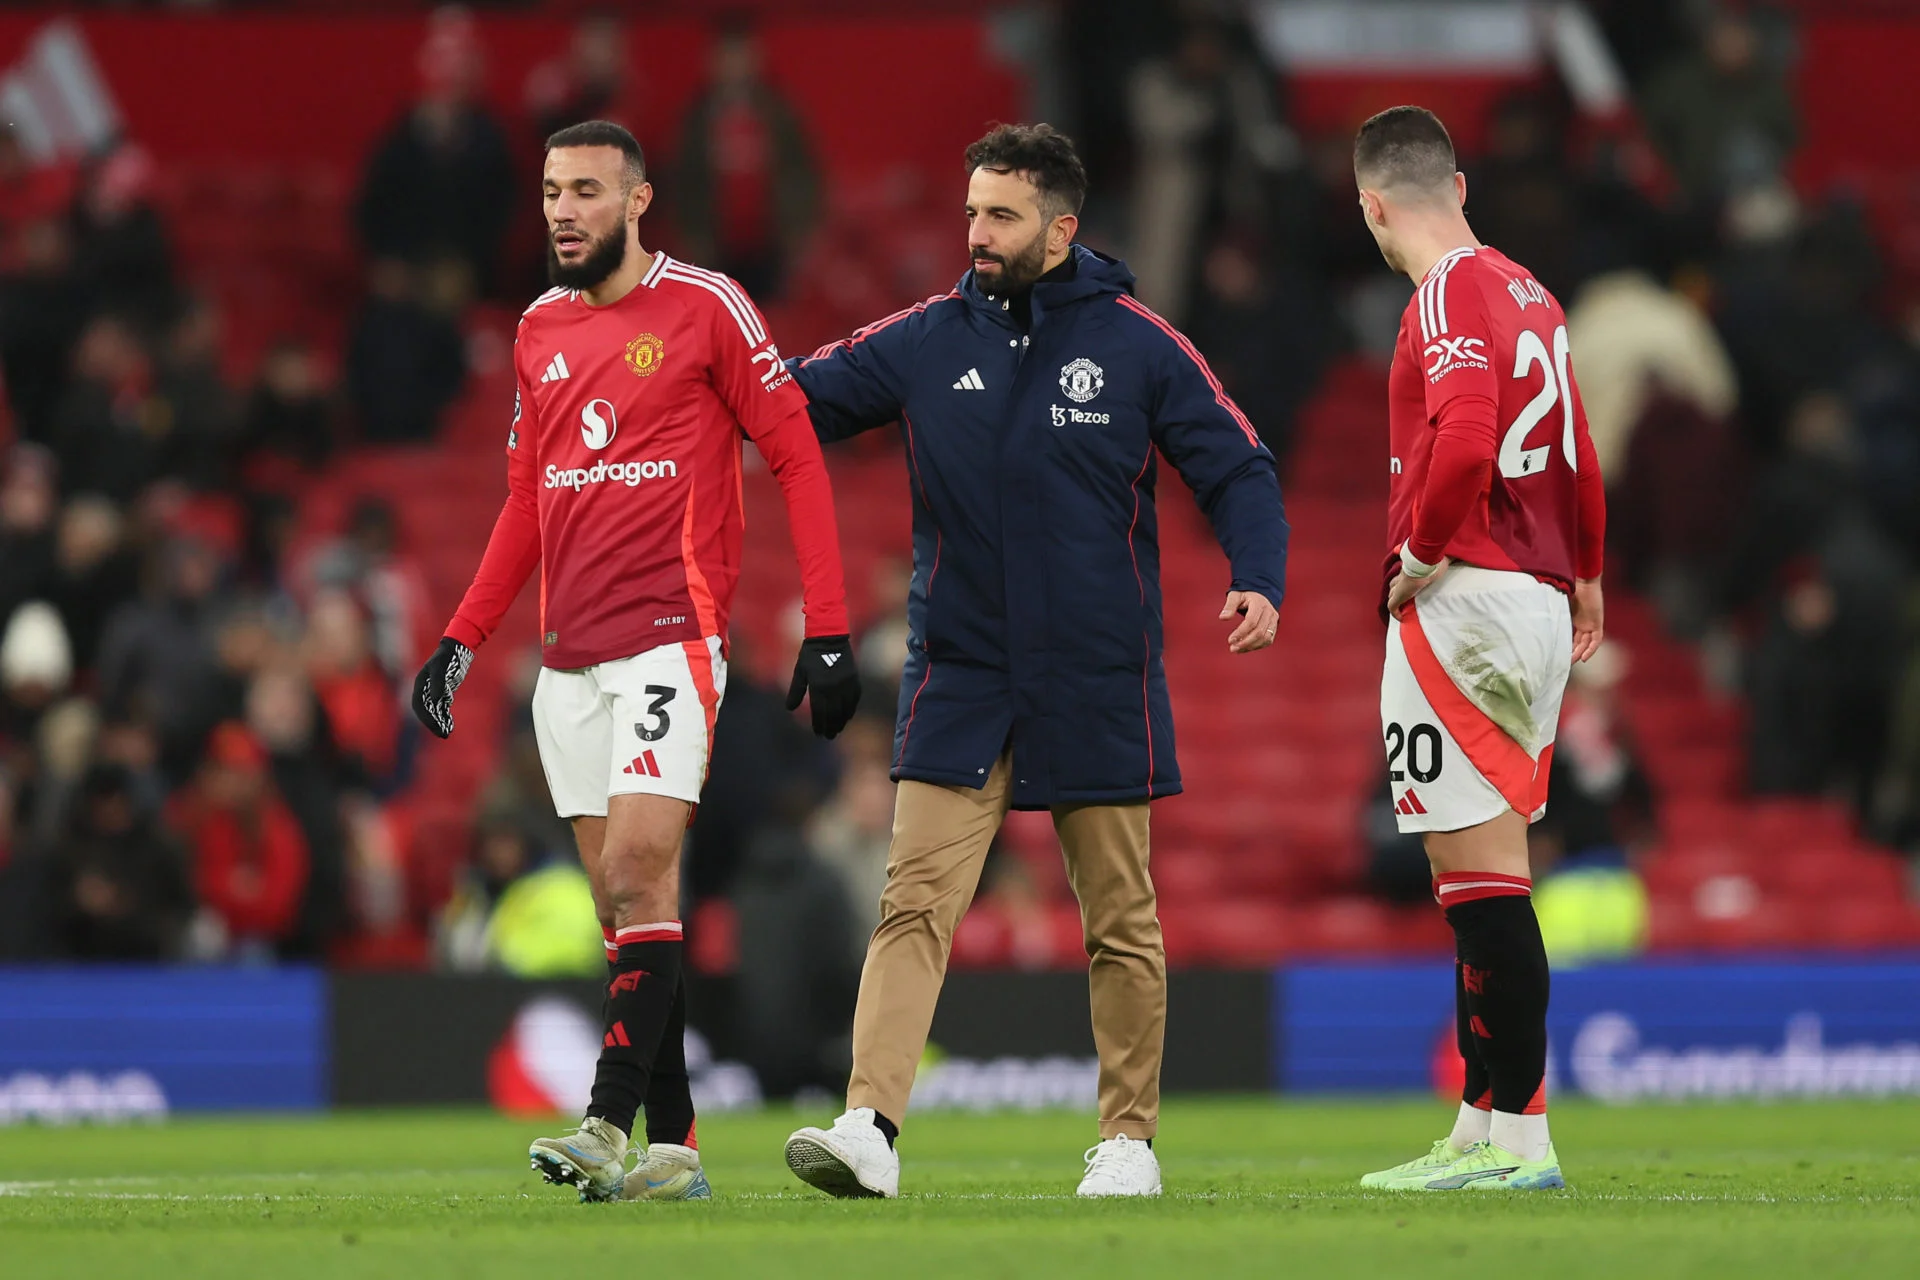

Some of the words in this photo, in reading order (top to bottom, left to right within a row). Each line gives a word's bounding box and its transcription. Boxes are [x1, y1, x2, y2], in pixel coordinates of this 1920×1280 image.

[1064, 361, 1100, 377] MANCHESTER
[1429, 361, 1489, 385] TECHNOLOGY
[1068, 391, 1094, 400] UNITED
[1067, 408, 1110, 425] Tezos
[544, 458, 677, 492] Snapdragon
[653, 615, 686, 627] HEAT.RDY
[634, 684, 677, 742] 3
[1385, 721, 1443, 784] 20
